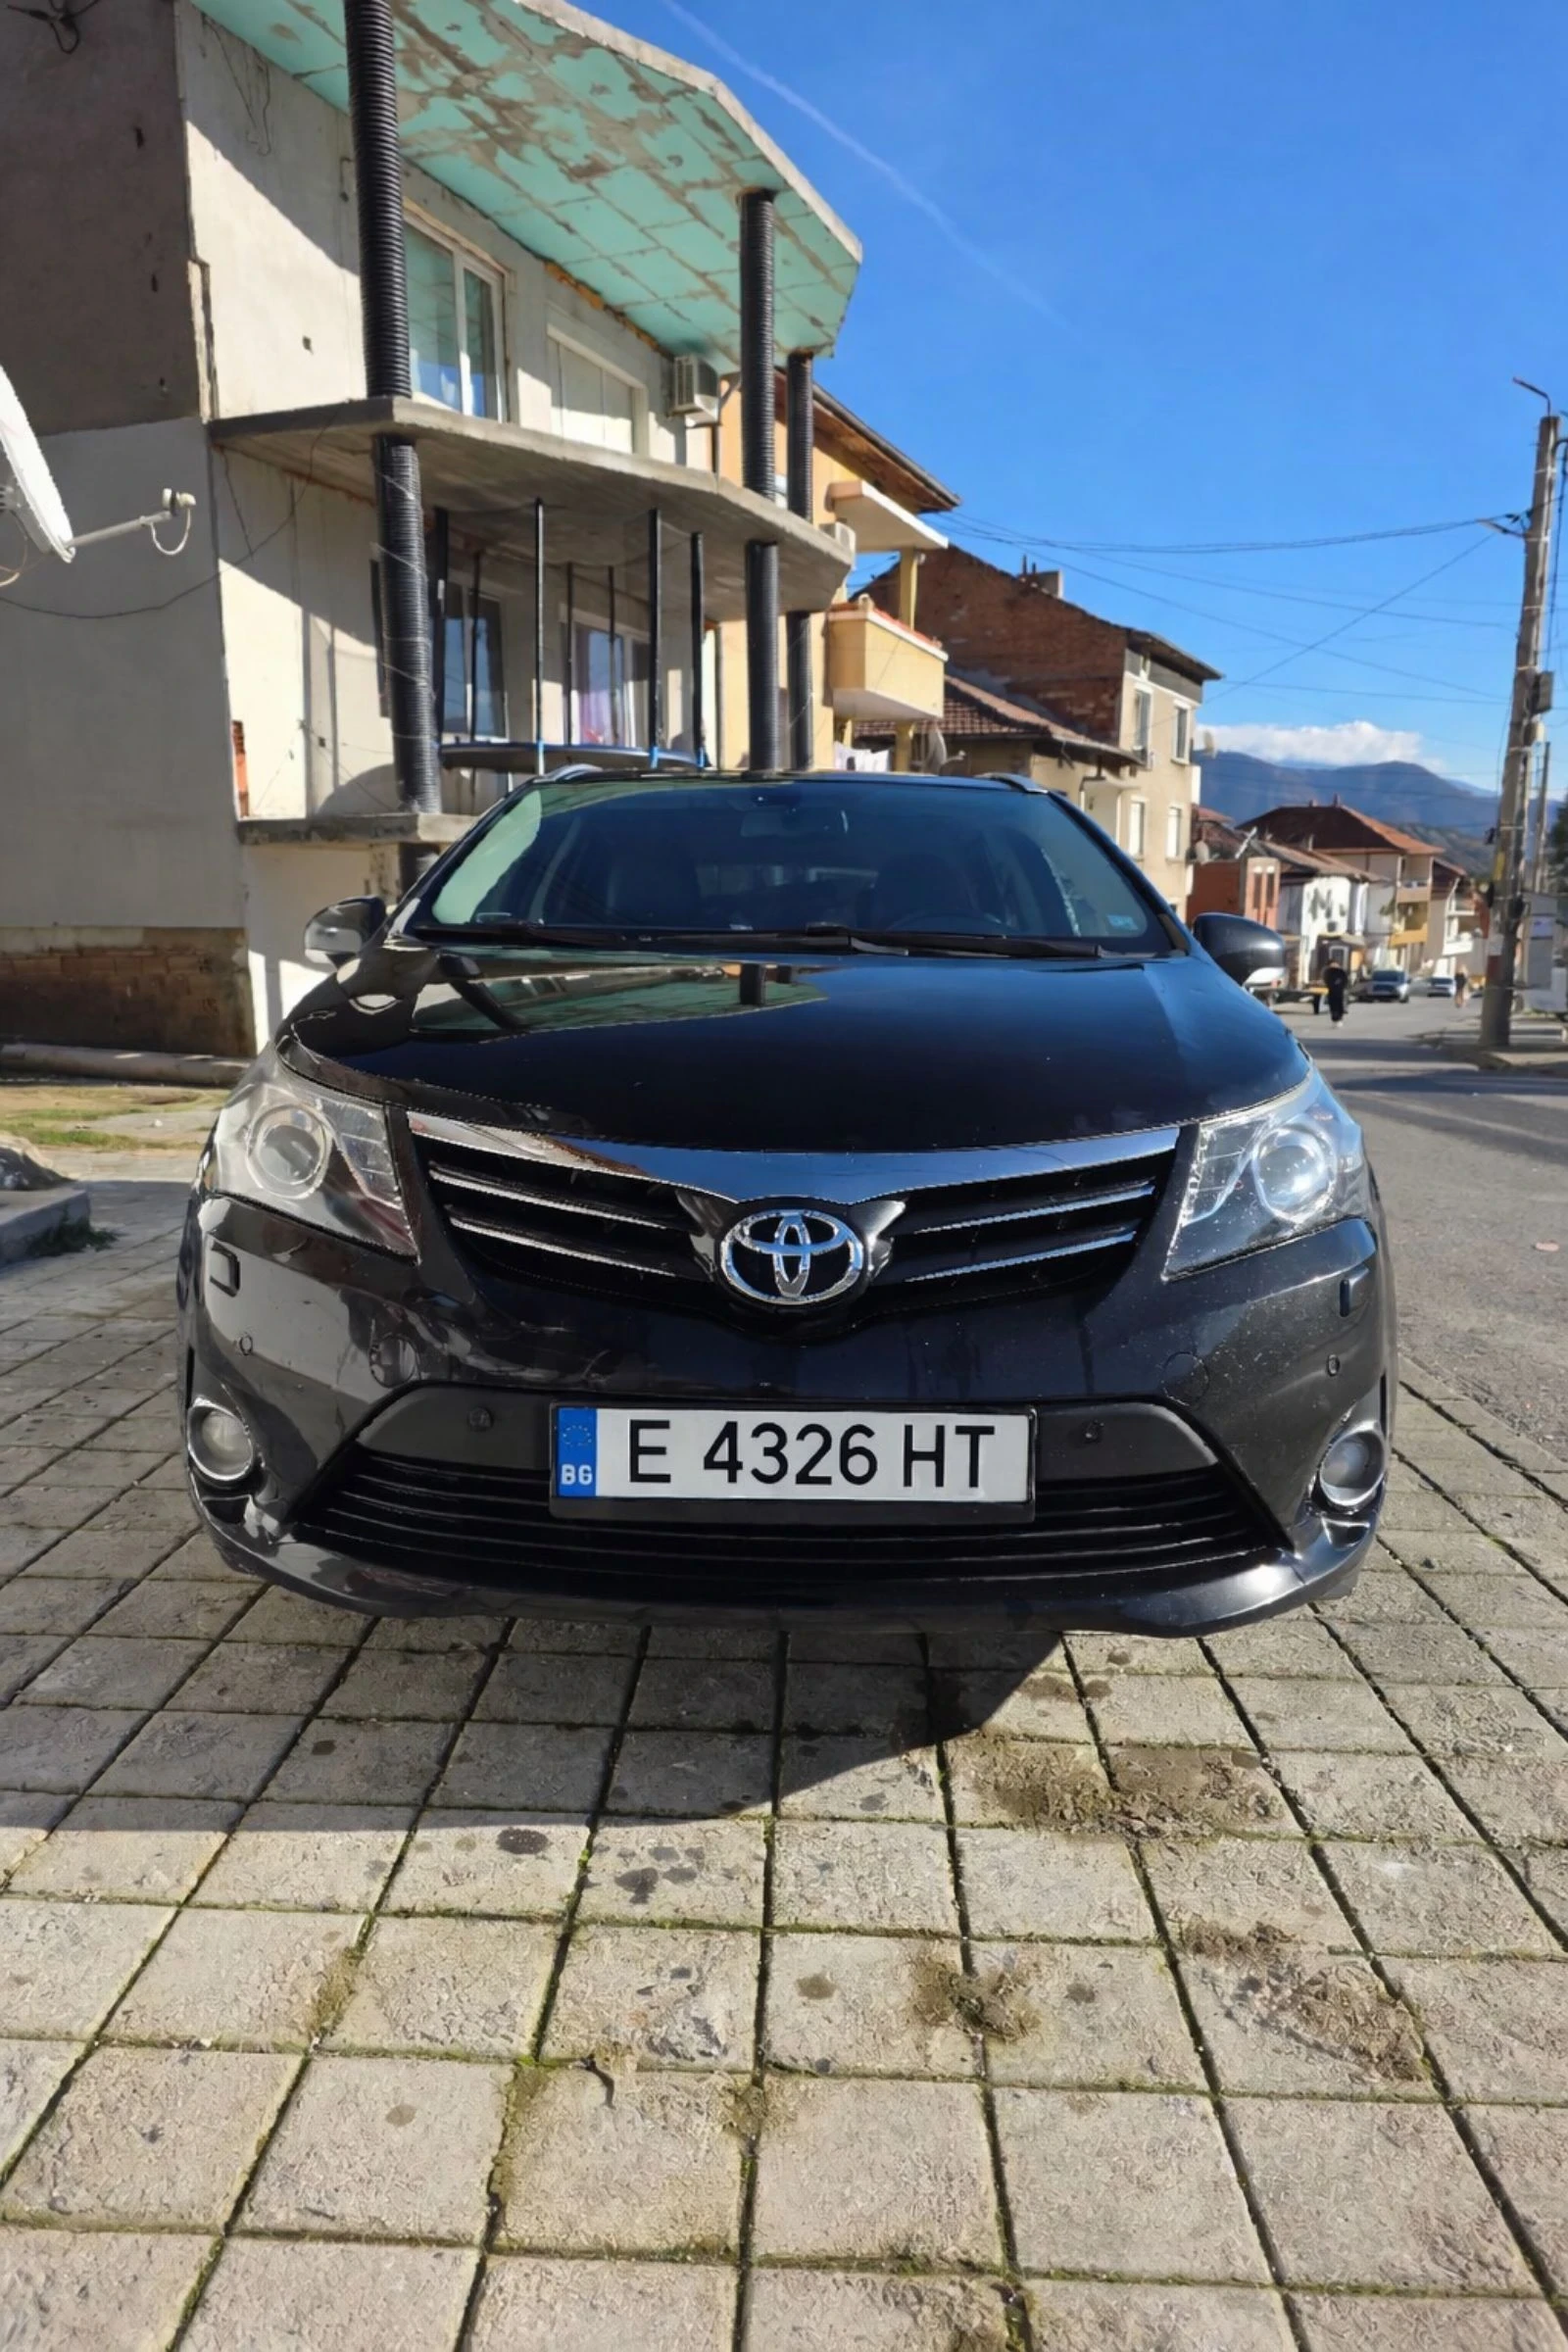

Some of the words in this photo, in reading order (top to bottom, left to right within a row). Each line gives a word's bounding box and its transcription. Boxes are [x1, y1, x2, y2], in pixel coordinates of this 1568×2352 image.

[562, 1464, 593, 1486] BG
[629, 1419, 671, 1484] E
[703, 1421, 878, 1486] 4326
[904, 1424, 996, 1488] HT
